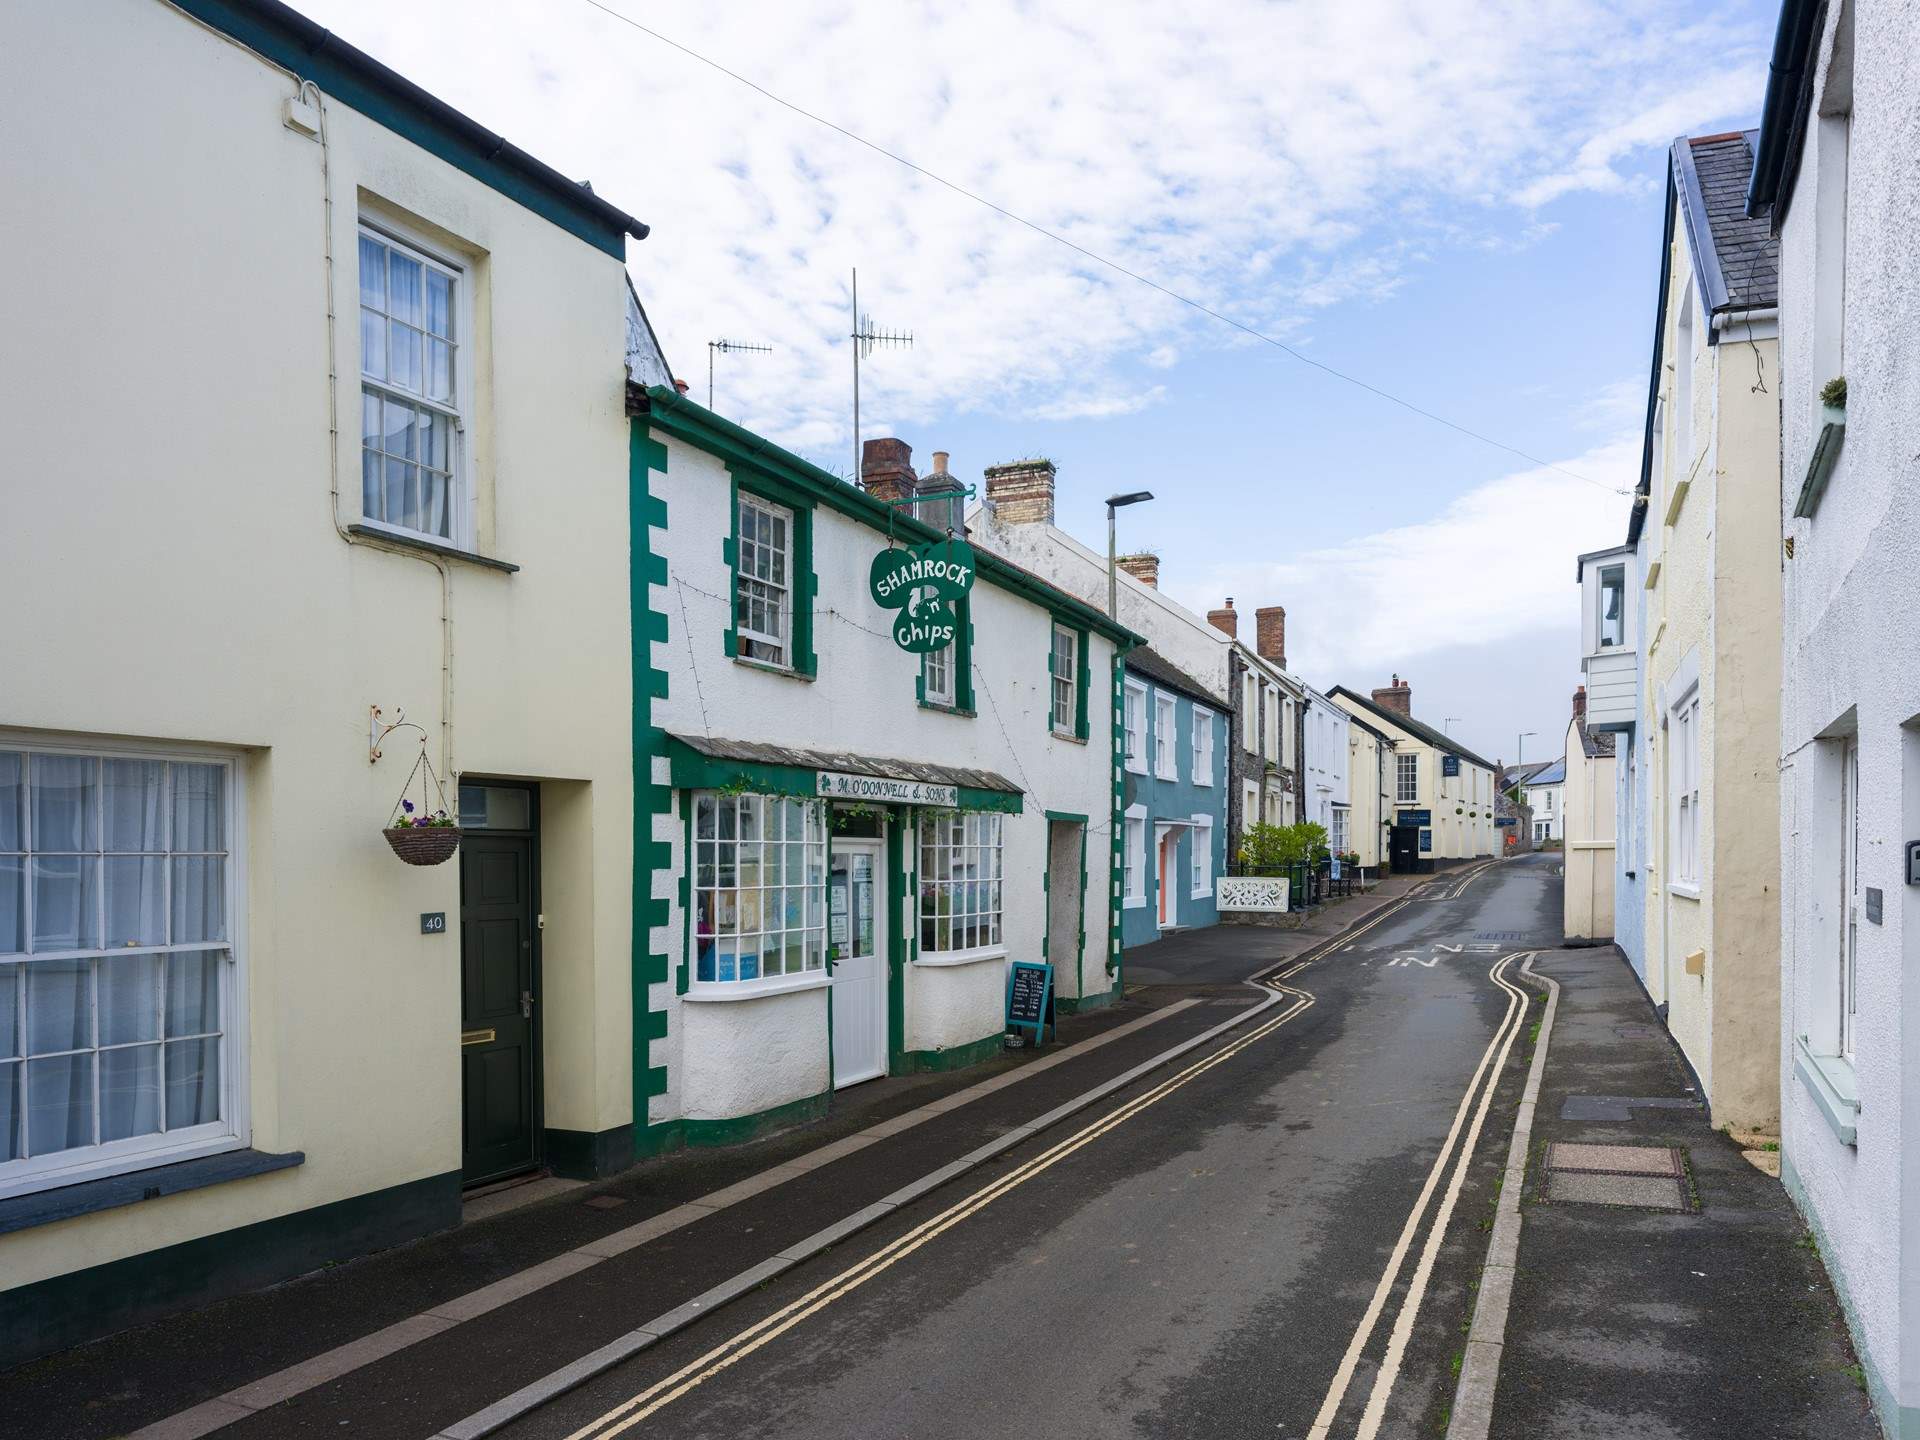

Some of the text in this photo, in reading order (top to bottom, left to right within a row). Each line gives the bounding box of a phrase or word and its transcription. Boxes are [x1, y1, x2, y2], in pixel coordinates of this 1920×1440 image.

[877, 559, 972, 597] SHAMROCK
[927, 598, 940, 614] 'n'
[898, 615, 954, 646] Chips
[837, 777, 947, 802] M. O'DONNELL & SONS
[426, 917, 442, 929] 40
